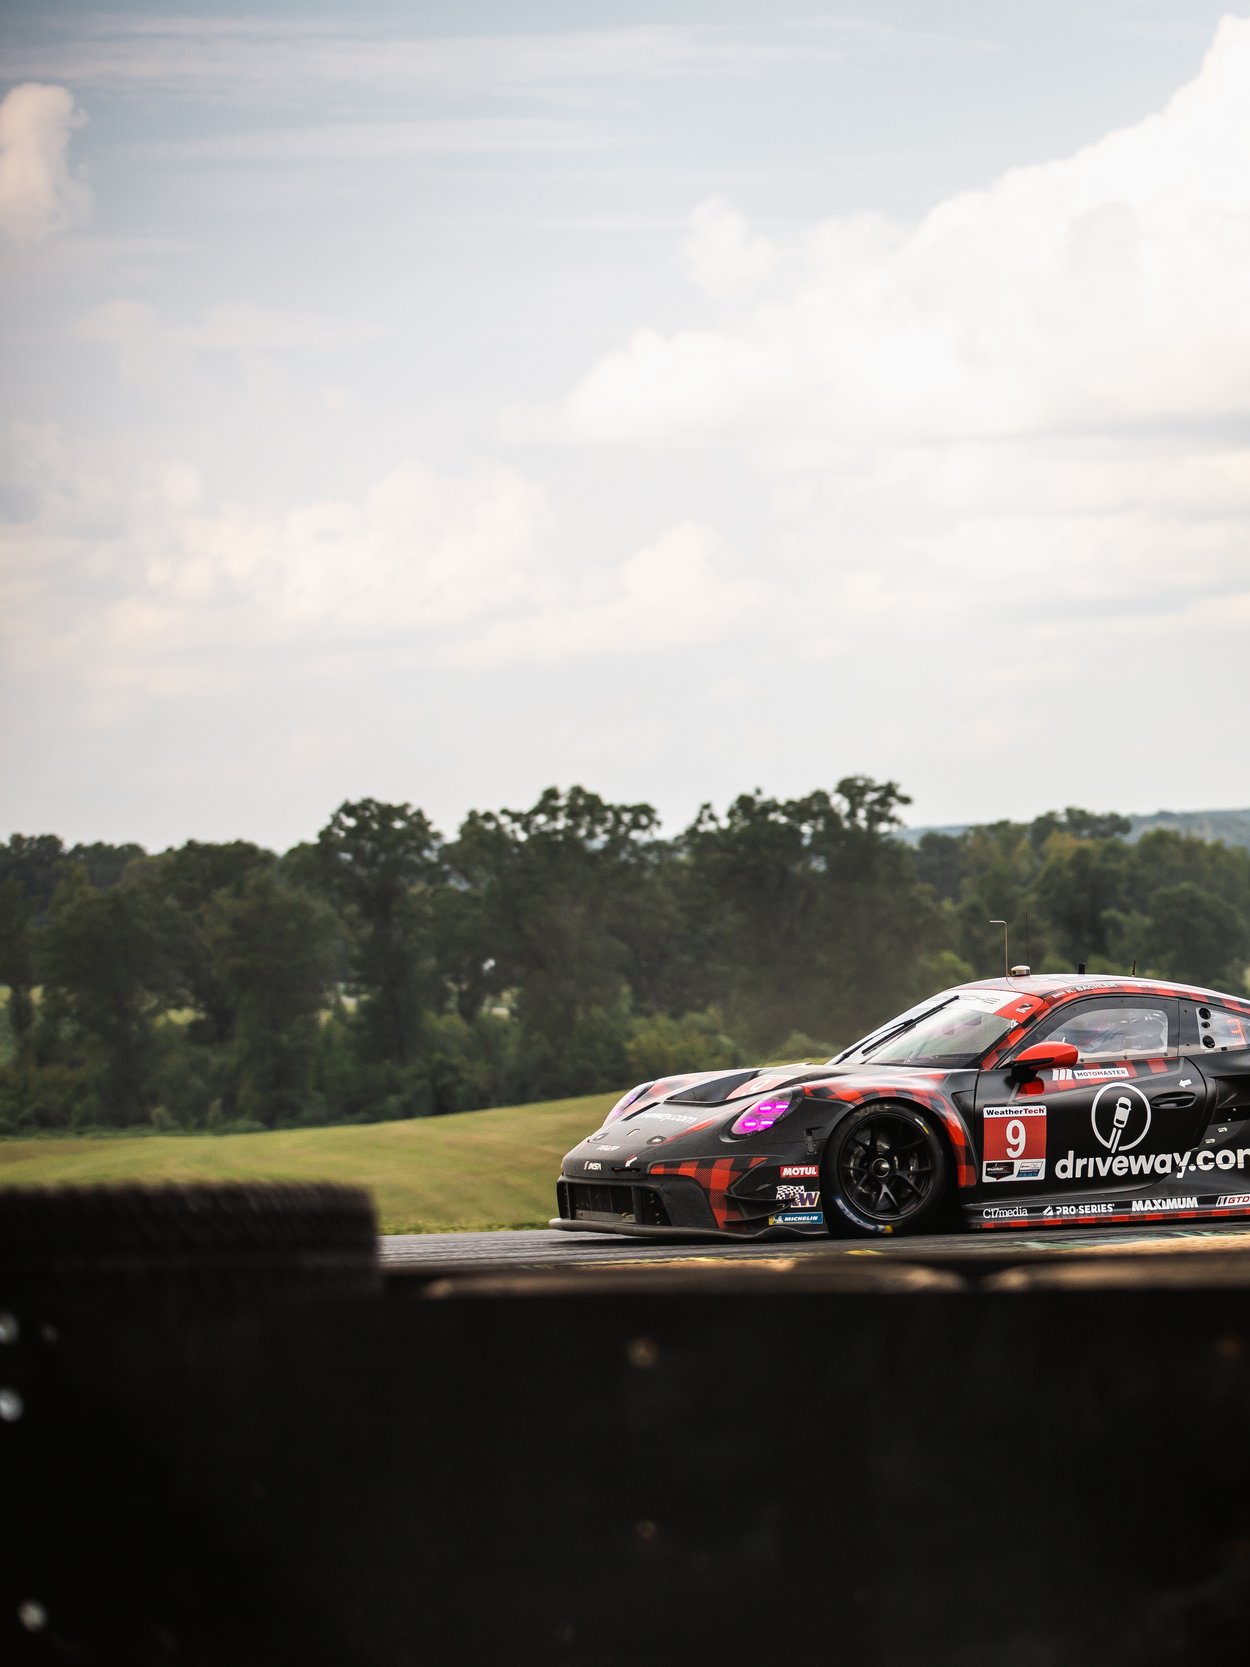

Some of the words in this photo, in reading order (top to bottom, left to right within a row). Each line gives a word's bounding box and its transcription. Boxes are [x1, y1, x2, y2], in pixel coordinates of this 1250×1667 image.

[1077, 1069, 1127, 1077] MOTOMASTER
[986, 1107, 1045, 1116] WeatherTech
[1006, 1119, 1026, 1158] 9
[783, 1167, 817, 1176] MOTUL
[1132, 1196, 1199, 1212] MAXIMUM
[983, 1207, 1028, 1219] C17media
